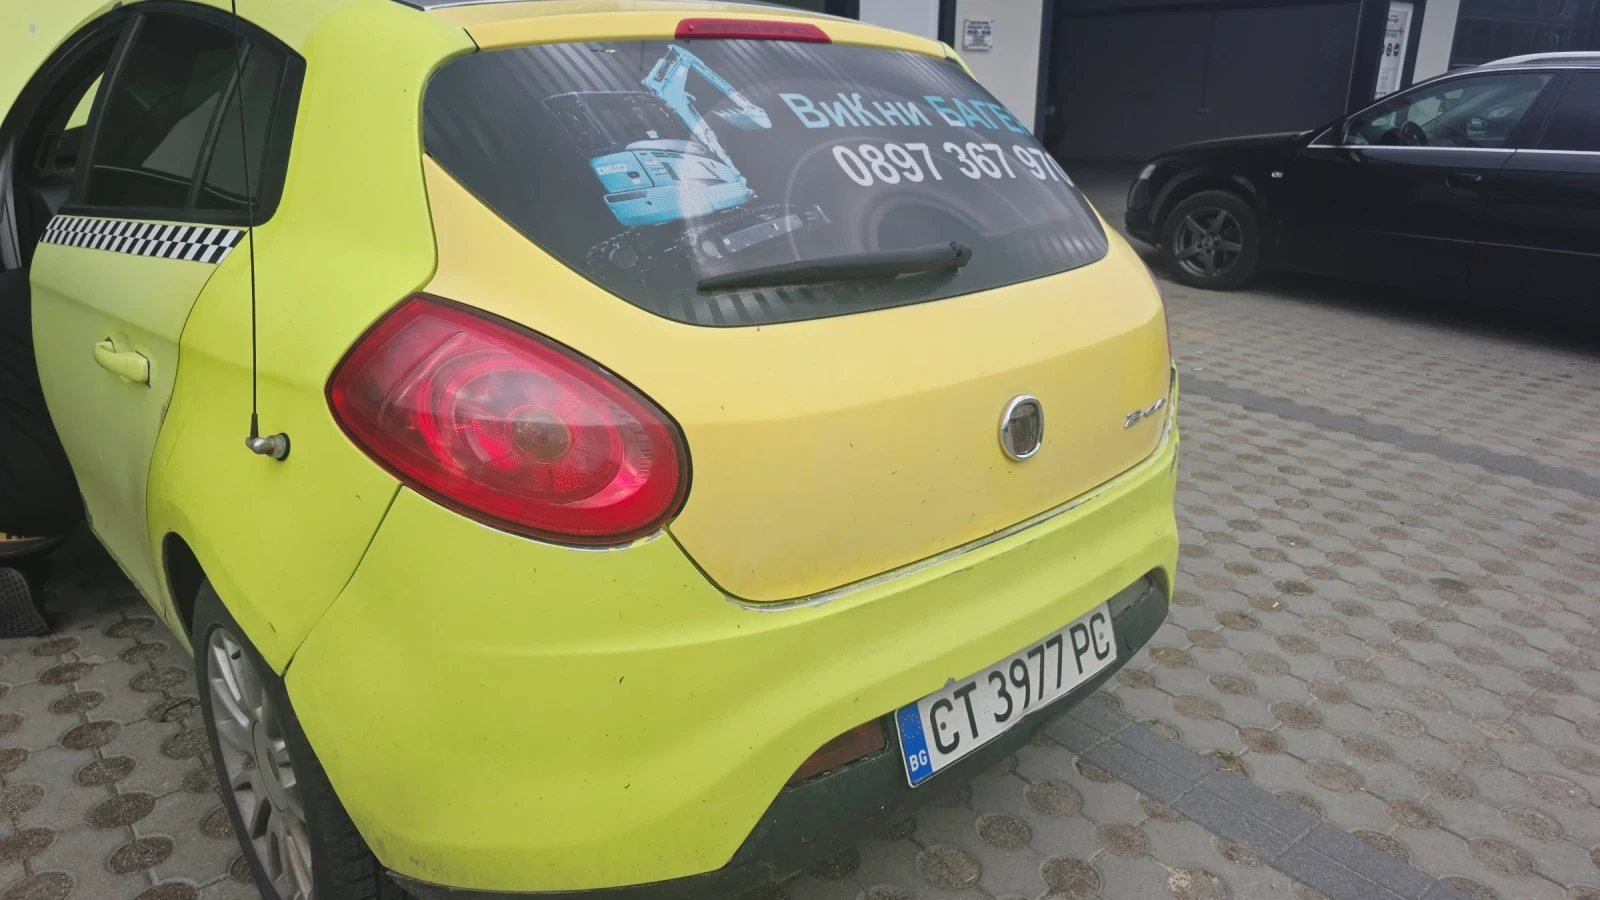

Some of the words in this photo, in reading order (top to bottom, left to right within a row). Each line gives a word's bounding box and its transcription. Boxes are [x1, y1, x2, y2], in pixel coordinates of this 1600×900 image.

[832, 142, 943, 187] 0897
[943, 141, 1016, 180] 367
[988, 633, 1063, 723] 3977
[909, 749, 928, 773] BG
